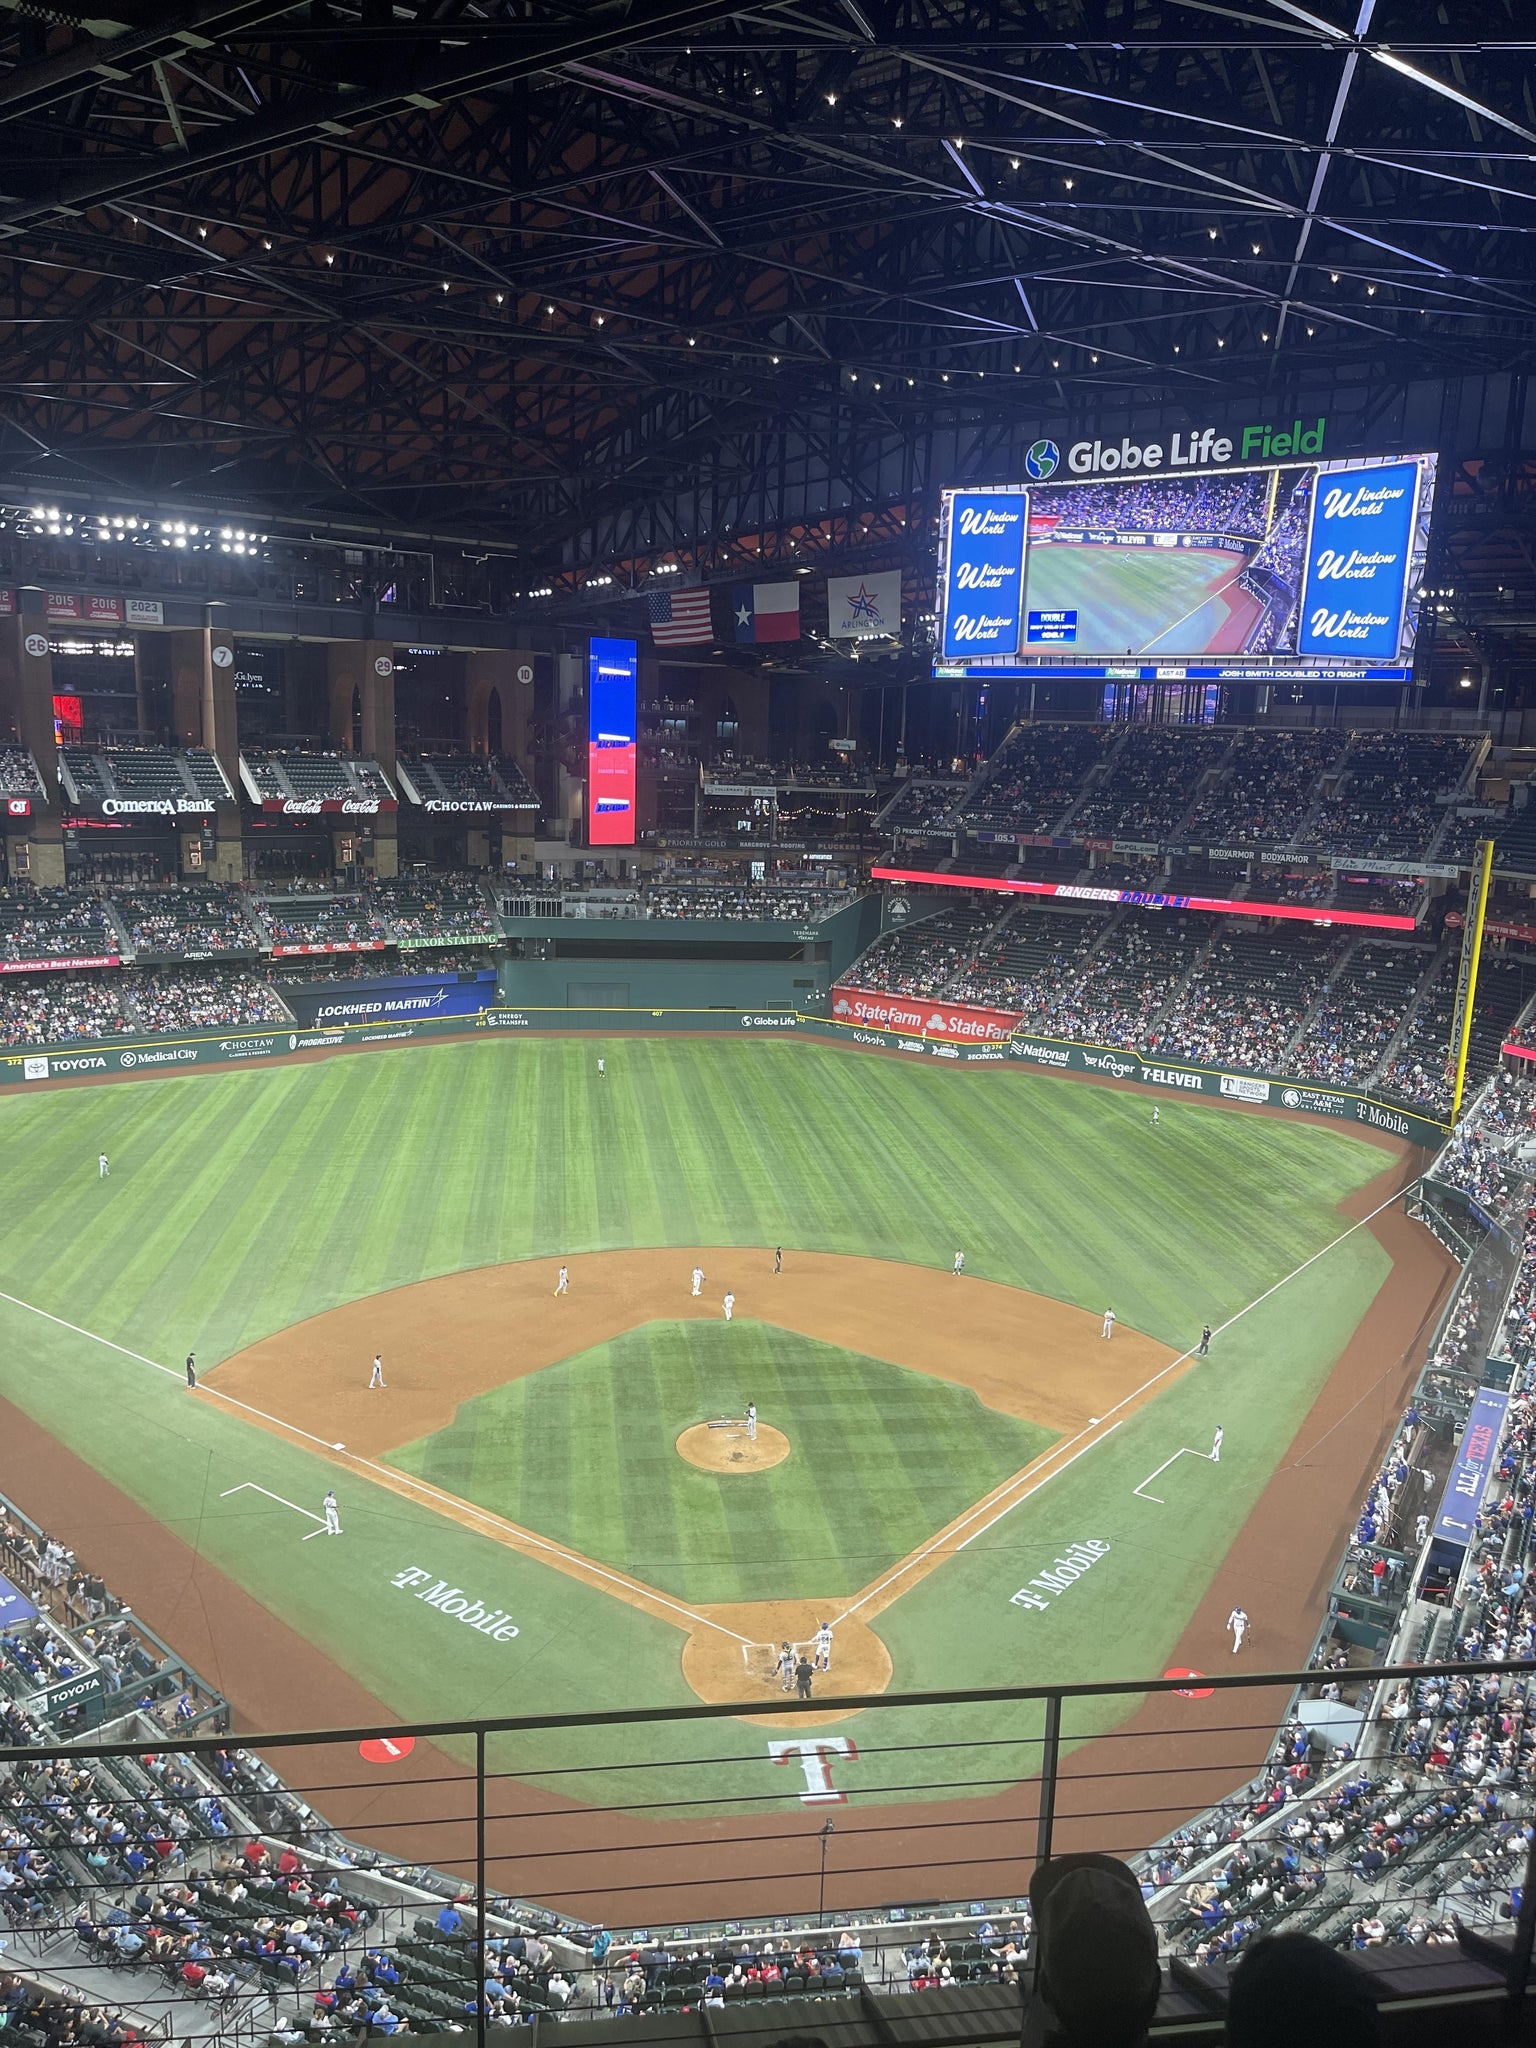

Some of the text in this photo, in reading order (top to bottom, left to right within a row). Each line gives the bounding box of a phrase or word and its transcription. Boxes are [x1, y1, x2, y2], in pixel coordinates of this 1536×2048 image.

[1068, 418, 1326, 473] Globe Life Field
[1323, 487, 1404, 519] Window
[960, 508, 1018, 534] Window
[1317, 550, 1397, 579] Window
[957, 563, 1015, 589] Window
[49, 594, 74, 606] 2015
[92, 598, 117, 609] 2016
[131, 601, 158, 613] 2023
[841, 619, 884, 629] ARLINGTON
[954, 614, 1012, 641] Window
[1311, 608, 1389, 638] Window
[27, 639, 45, 652] 26
[219, 651, 227, 662] 7
[376, 661, 391, 671] 29
[520, 670, 529, 680] 10
[10, 801, 28, 813] QT
[177, 799, 216, 813] Bank
[431, 801, 492, 811] CHOCTAW
[902, 828, 956, 838] PRIORITY COMMERCE
[994, 834, 1015, 843] 105.3
[667, 839, 702, 847] PRIORITY
[1092, 842, 1110, 850] PGL
[1167, 847, 1185, 856] PGL
[1209, 848, 1255, 859] BODYARMOR
[1261, 852, 1309, 864] BODYARMOR
[1055, 885, 1120, 901] RANGERS
[356, 941, 374, 949] DEX
[408, 934, 497, 947] LUXOR STAFFING
[3, 961, 49, 970] America's
[71, 958, 110, 966] Network
[318, 999, 431, 1018] LOCKHEED MARTIN
[754, 1017, 795, 1026] Globe Life
[226, 1039, 274, 1048] CHOCTAW
[298, 1036, 345, 1048] PROGRESSIVE
[853, 1032, 886, 1047] Kubota
[138, 1049, 199, 1064] Medical City
[1023, 1044, 1070, 1062] National
[51, 1057, 107, 1072] TOYOTA
[1098, 1055, 1136, 1078] Kroger
[1141, 1066, 1202, 1089] 7-ELEVEN
[1313, 1100, 1332, 1108] A&M
[1322, 1095, 1345, 1103] TEXAS
[1301, 1104, 1343, 1115] UNIVERSITY
[1368, 1109, 1409, 1135] Mobile
[1466, 1425, 1493, 1461] TEXAS
[1456, 1472, 1480, 1497] ALL
[1028, 1540, 1111, 1596] Mobile
[414, 1580, 519, 1641] Mobile
[51, 1678, 100, 1704] TOYOTA
[768, 1737, 859, 1806] T
